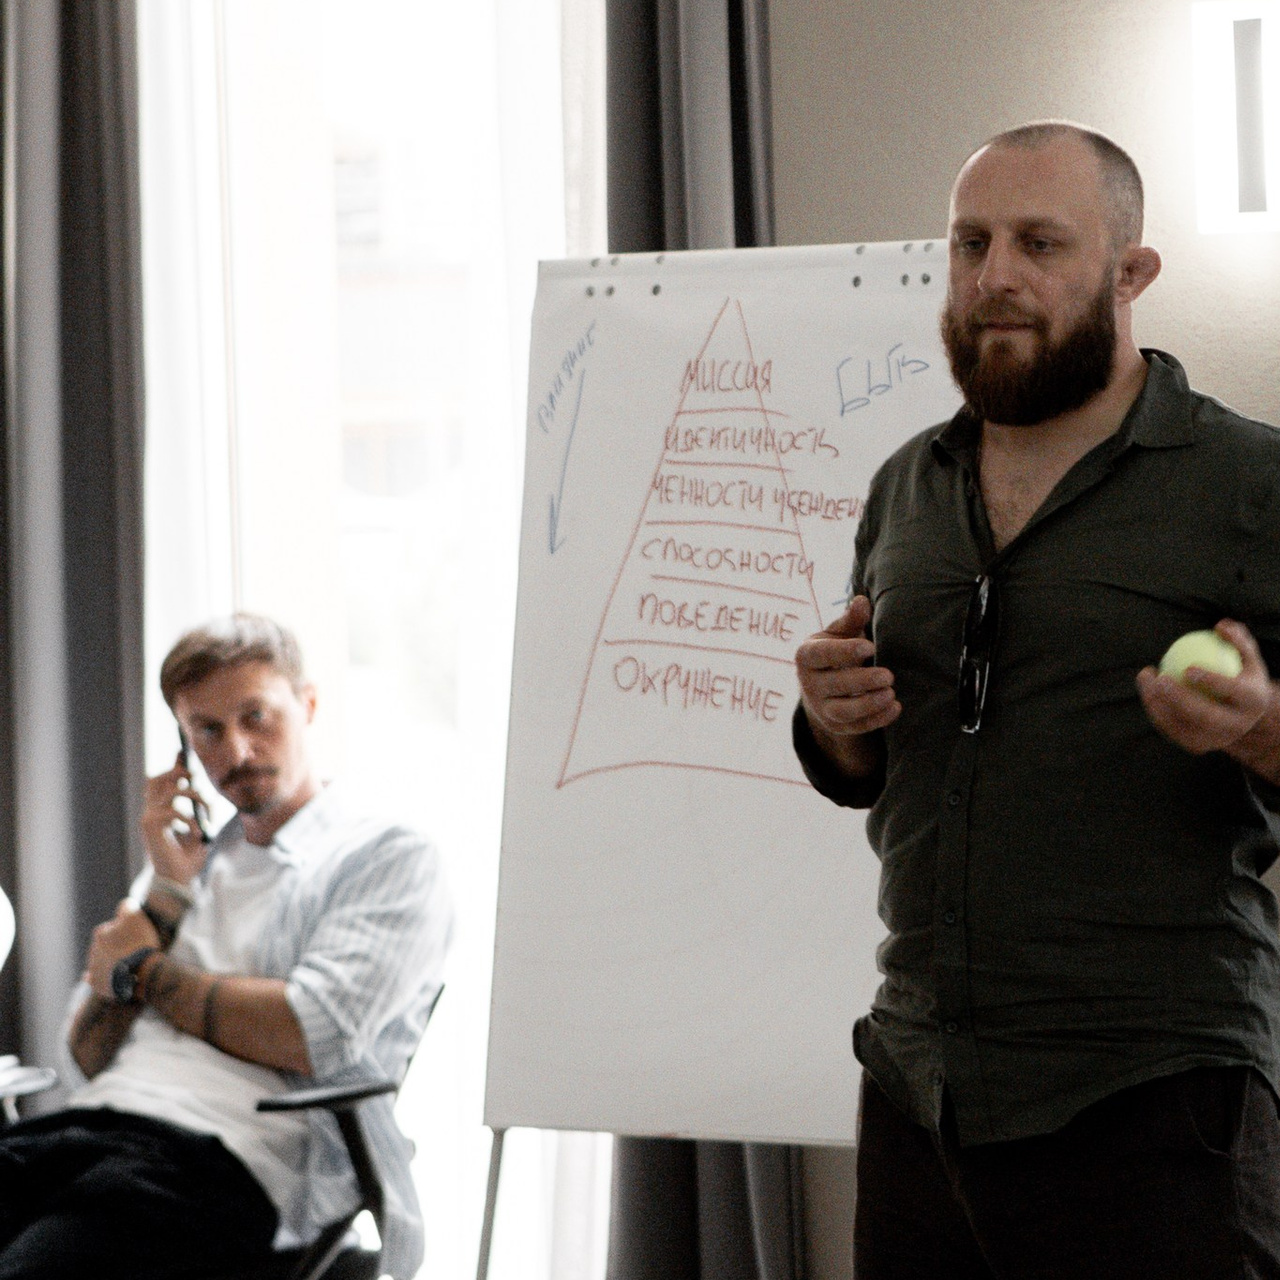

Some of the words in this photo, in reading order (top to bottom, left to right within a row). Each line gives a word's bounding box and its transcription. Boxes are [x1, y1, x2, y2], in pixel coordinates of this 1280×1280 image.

[679, 357, 773, 394] МИССИЯ
[836, 342, 930, 417] БЫТЬ
[664, 426, 840, 458] ИДЕНТИЧНОСТЬ
[772, 487, 866, 523] УБЕЖДЕН
[641, 537, 815, 580] СПОСОБНОСТИ
[638, 592, 801, 642] ПОВЕДЕНИЕ
[612, 655, 784, 722] ОКРУЖЕНИЕ
